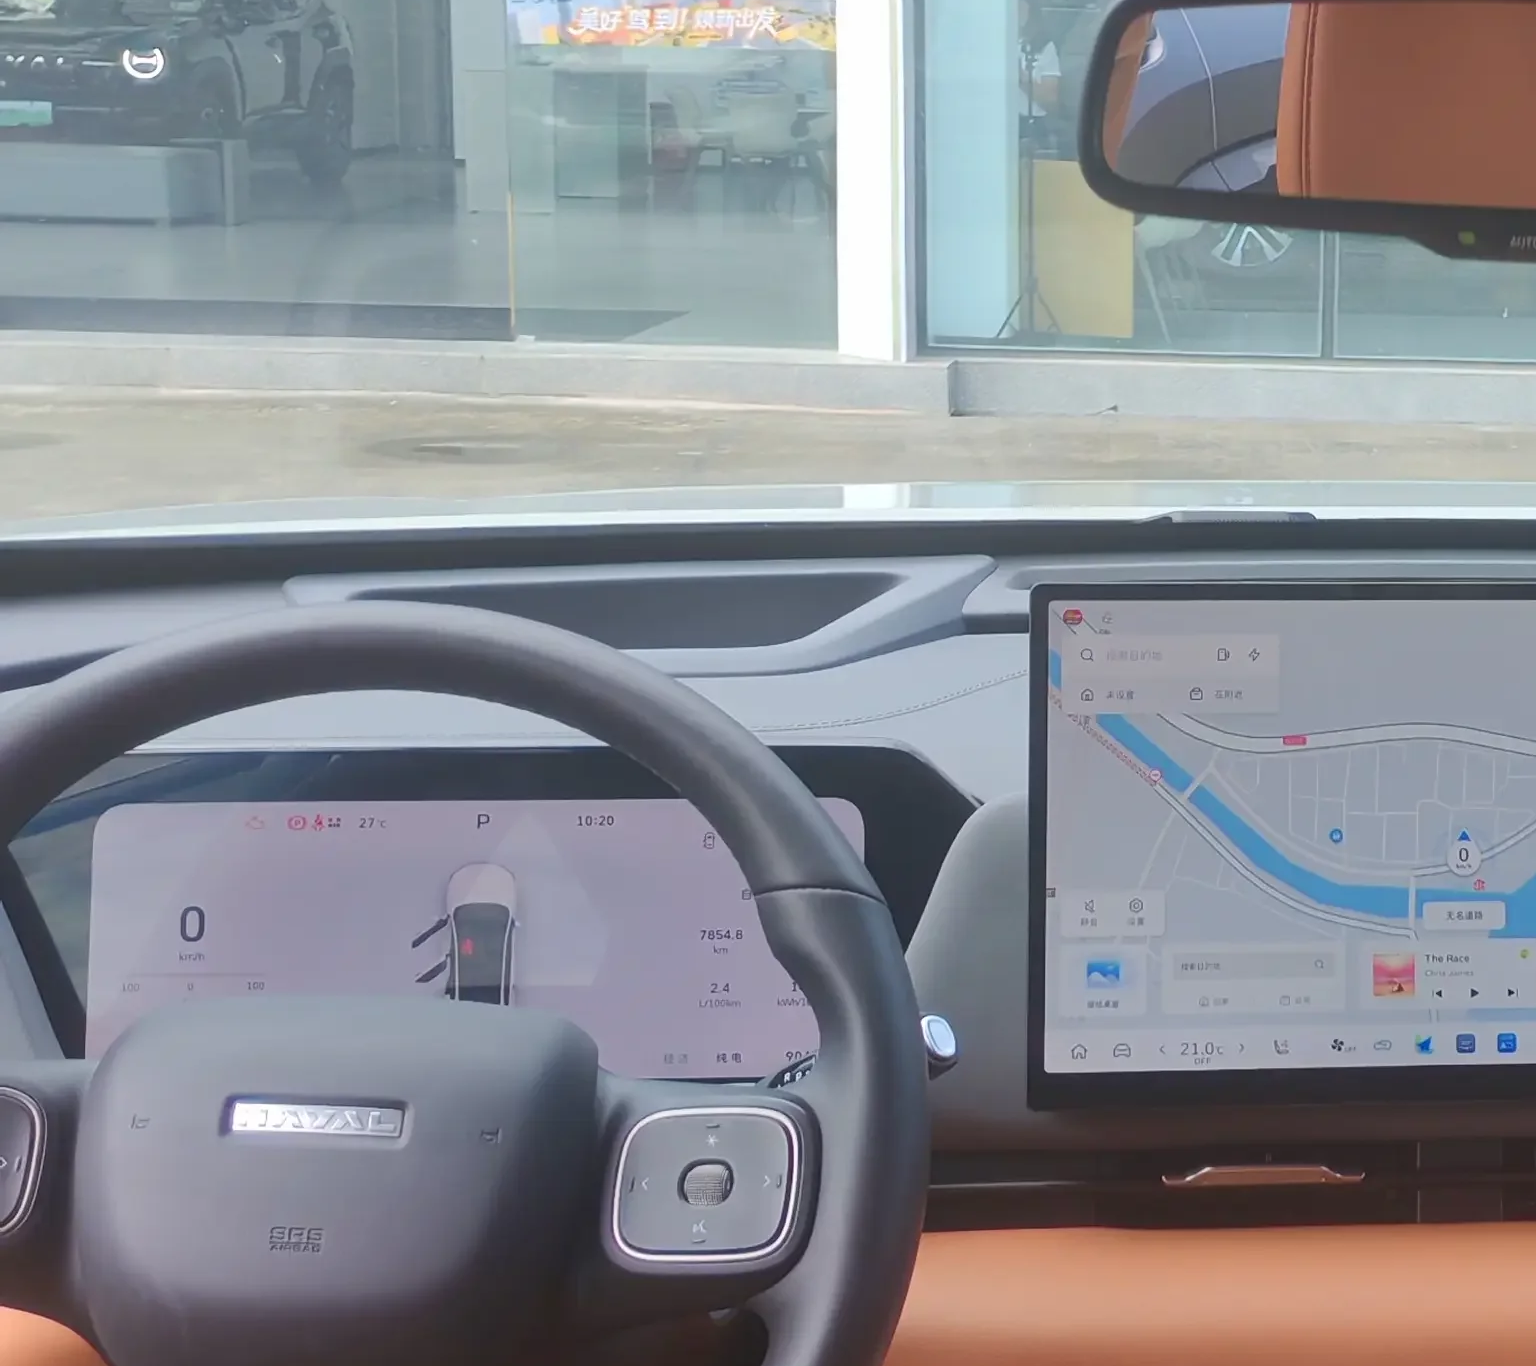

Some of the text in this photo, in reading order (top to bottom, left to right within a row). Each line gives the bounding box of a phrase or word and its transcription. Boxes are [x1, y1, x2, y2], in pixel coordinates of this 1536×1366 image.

[477, 813, 490, 830] P
[576, 814, 615, 827] 10:20
[1458, 846, 1470, 863] 0
[179, 905, 206, 943] 0
[699, 929, 744, 941] 7854.8
[712, 945, 729, 955] km
[1424, 953, 1470, 964] The Race
[186, 982, 194, 992] 0
[247, 980, 265, 991] 100
[710, 982, 730, 994] 2.4
[236, 1108, 397, 1133] HAVAL
[269, 1225, 324, 1242] SRS
